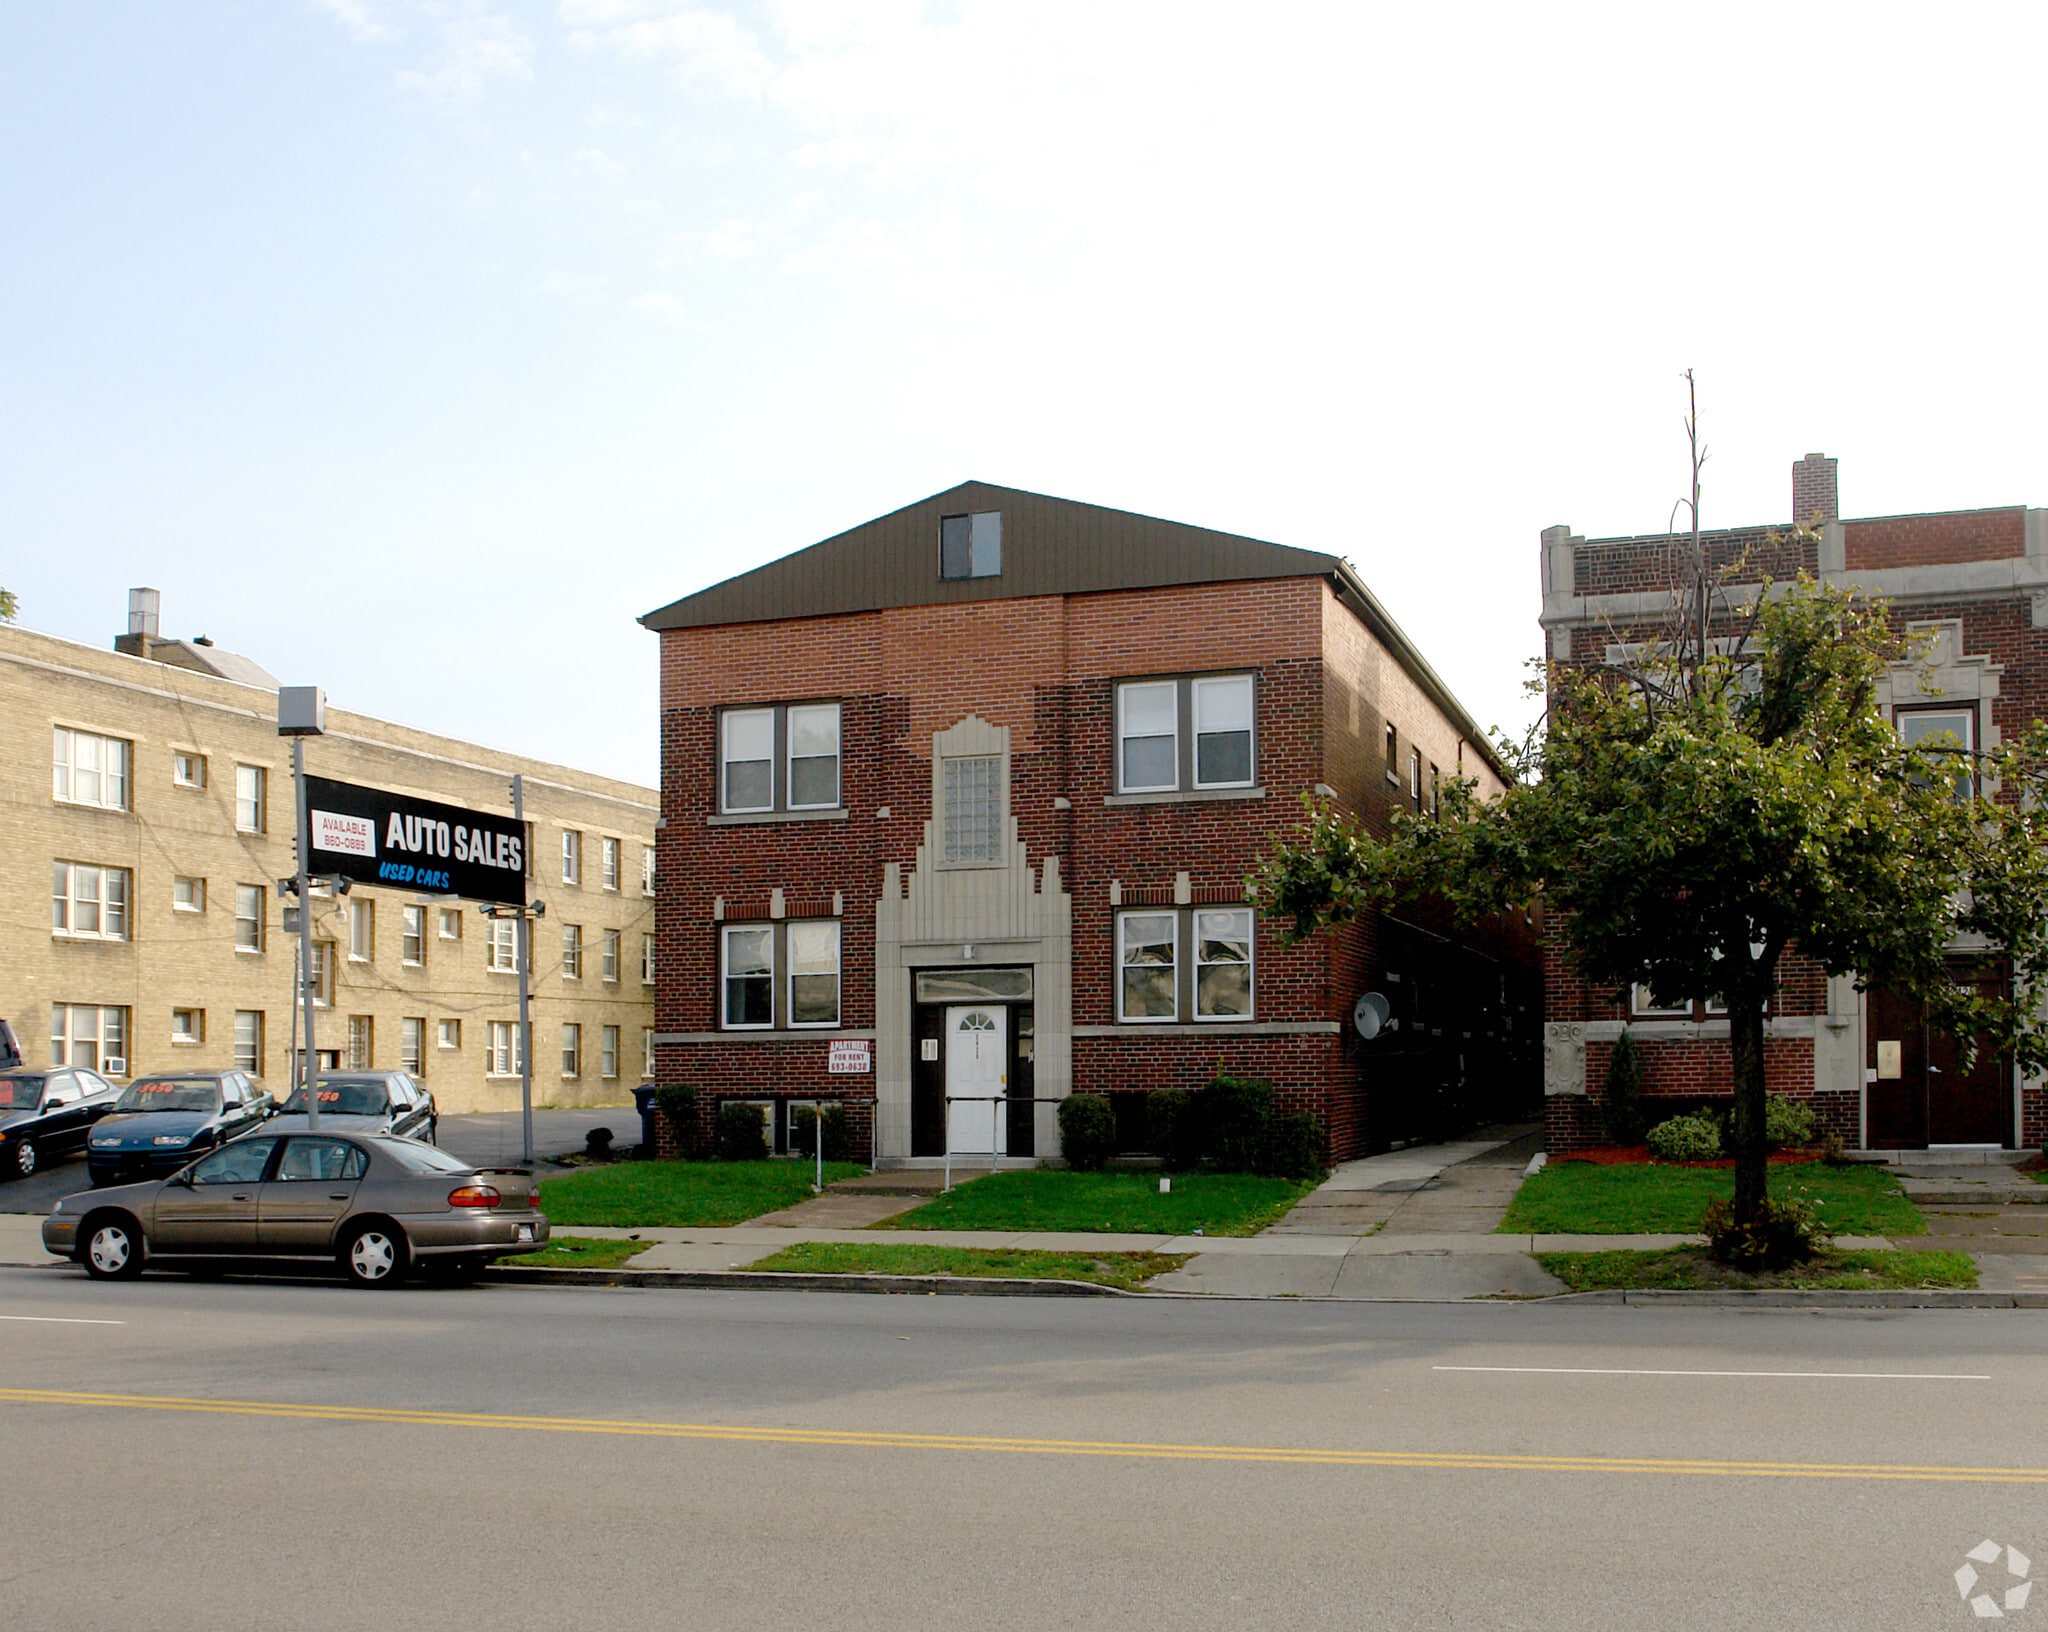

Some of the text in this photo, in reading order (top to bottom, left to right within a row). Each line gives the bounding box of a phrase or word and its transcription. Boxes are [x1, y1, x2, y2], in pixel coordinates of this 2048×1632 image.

[322, 817, 367, 836] AVAILABLE
[385, 812, 522, 871] AUTO SALES
[379, 861, 449, 888] USED CARS
[829, 1040, 870, 1052] APARTMENT
[834, 1053, 865, 1061] FOR RENT
